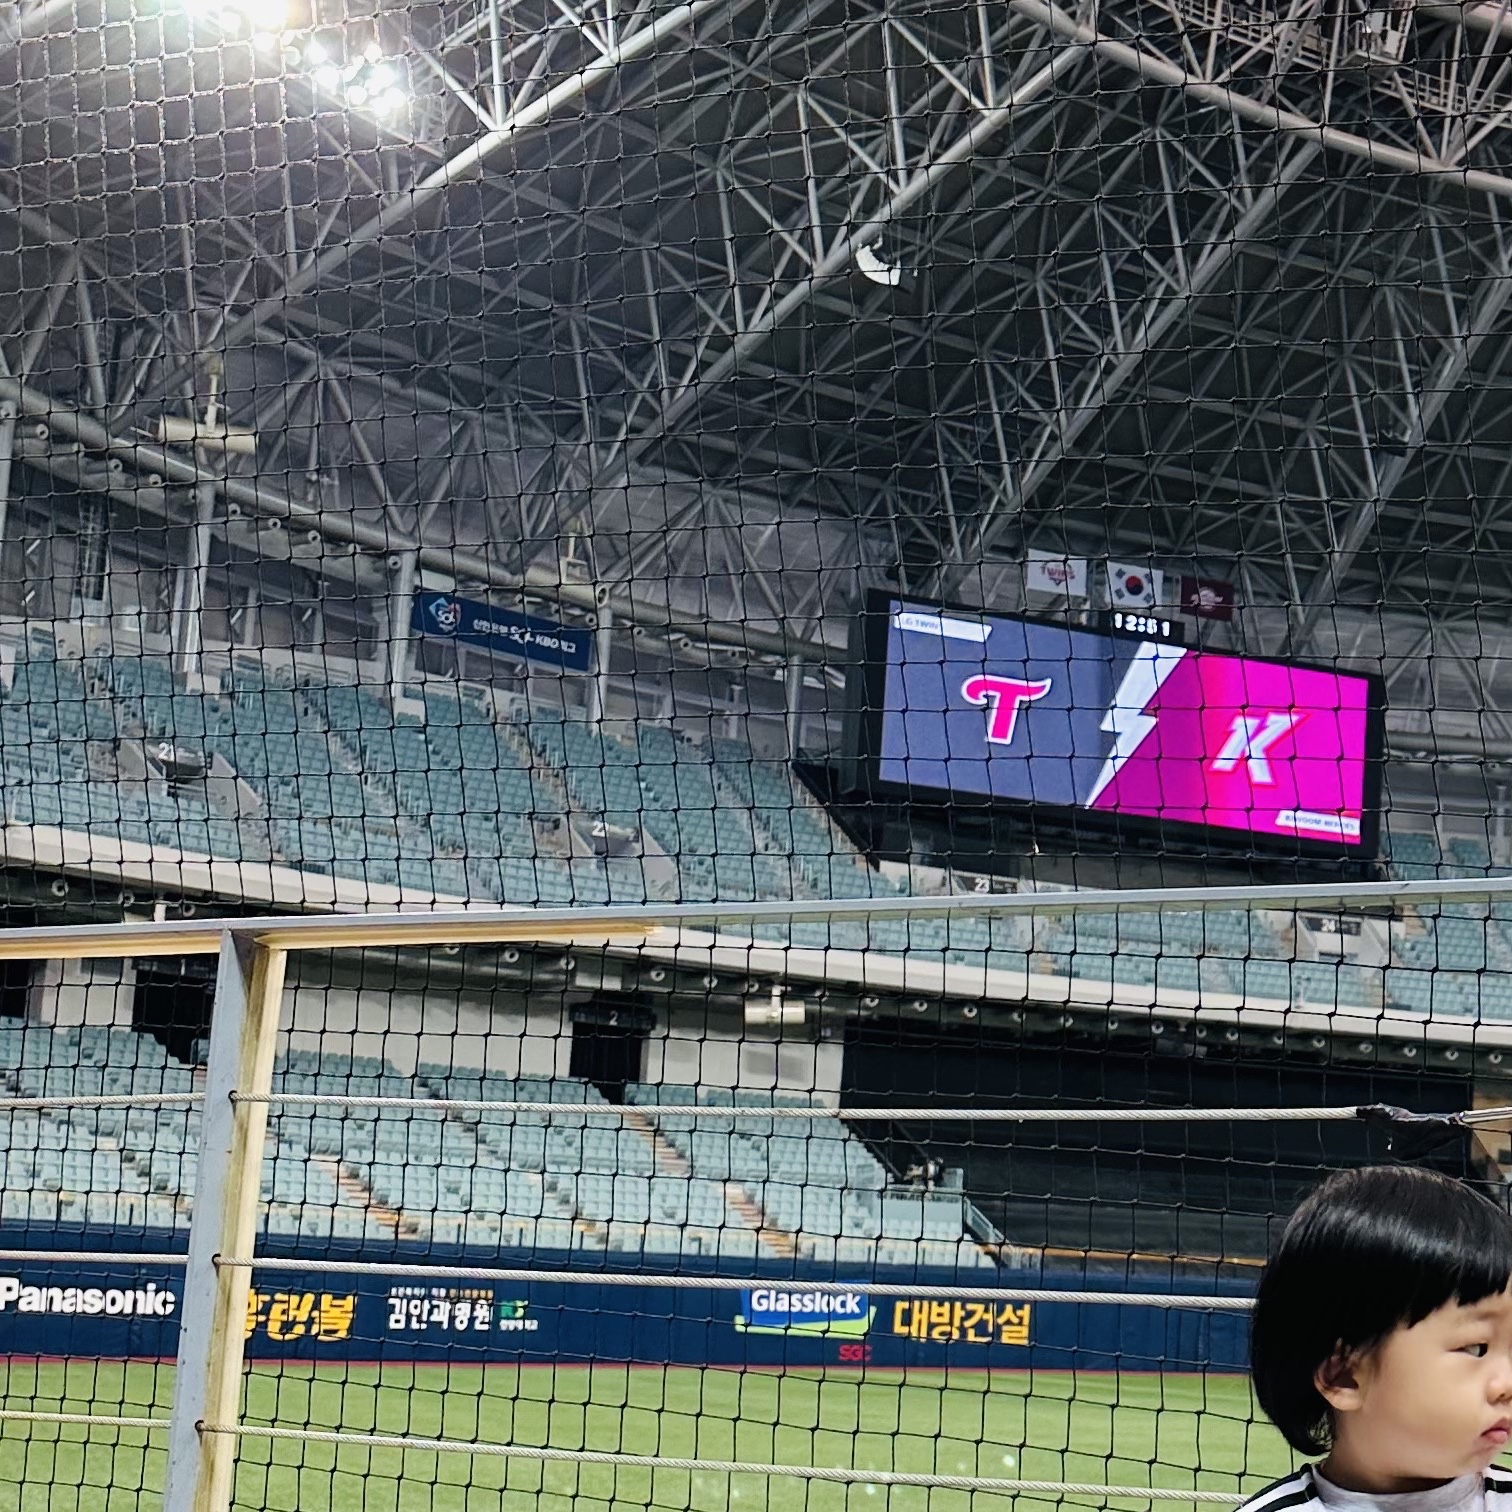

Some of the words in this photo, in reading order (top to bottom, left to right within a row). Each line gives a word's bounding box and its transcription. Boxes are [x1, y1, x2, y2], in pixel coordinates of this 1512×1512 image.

[961, 674, 1052, 745] T
[158, 742, 175, 762] 21
[1208, 711, 1312, 788] K
[0, 1276, 176, 1317] Panasonic
[751, 1289, 862, 1314] Glasslock
[893, 1300, 1032, 1346] 대방건설
